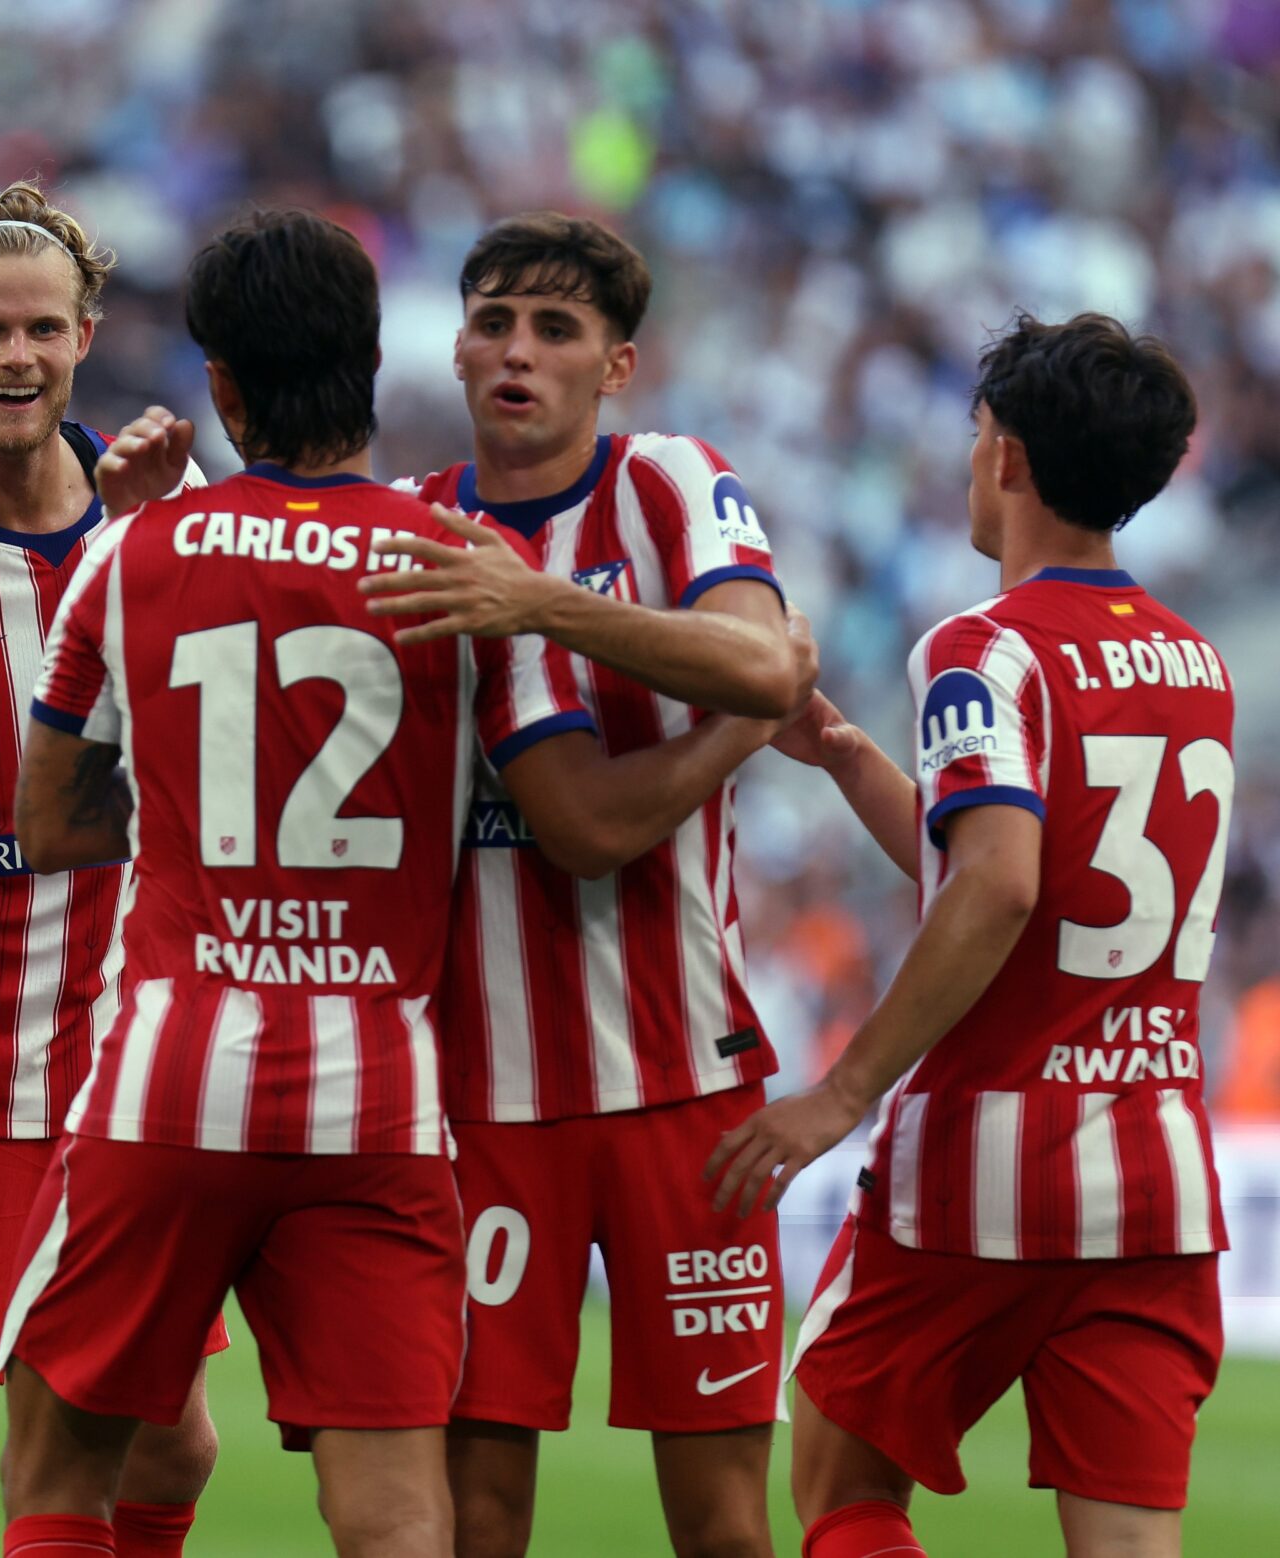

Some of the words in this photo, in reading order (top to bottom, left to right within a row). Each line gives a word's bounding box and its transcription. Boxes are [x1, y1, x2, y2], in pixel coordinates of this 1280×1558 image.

[173, 511, 361, 571] CARLOS
[1059, 643, 1102, 690] J.
[1098, 631, 1227, 692] BOÑAR
[168, 619, 404, 871] 12
[1057, 734, 1236, 983] 32
[220, 898, 350, 941] VISIT
[194, 932, 398, 985] RWANDA
[467, 1205, 531, 1307] 0
[666, 1244, 769, 1286] ERGO
[672, 1300, 770, 1337] DKV
